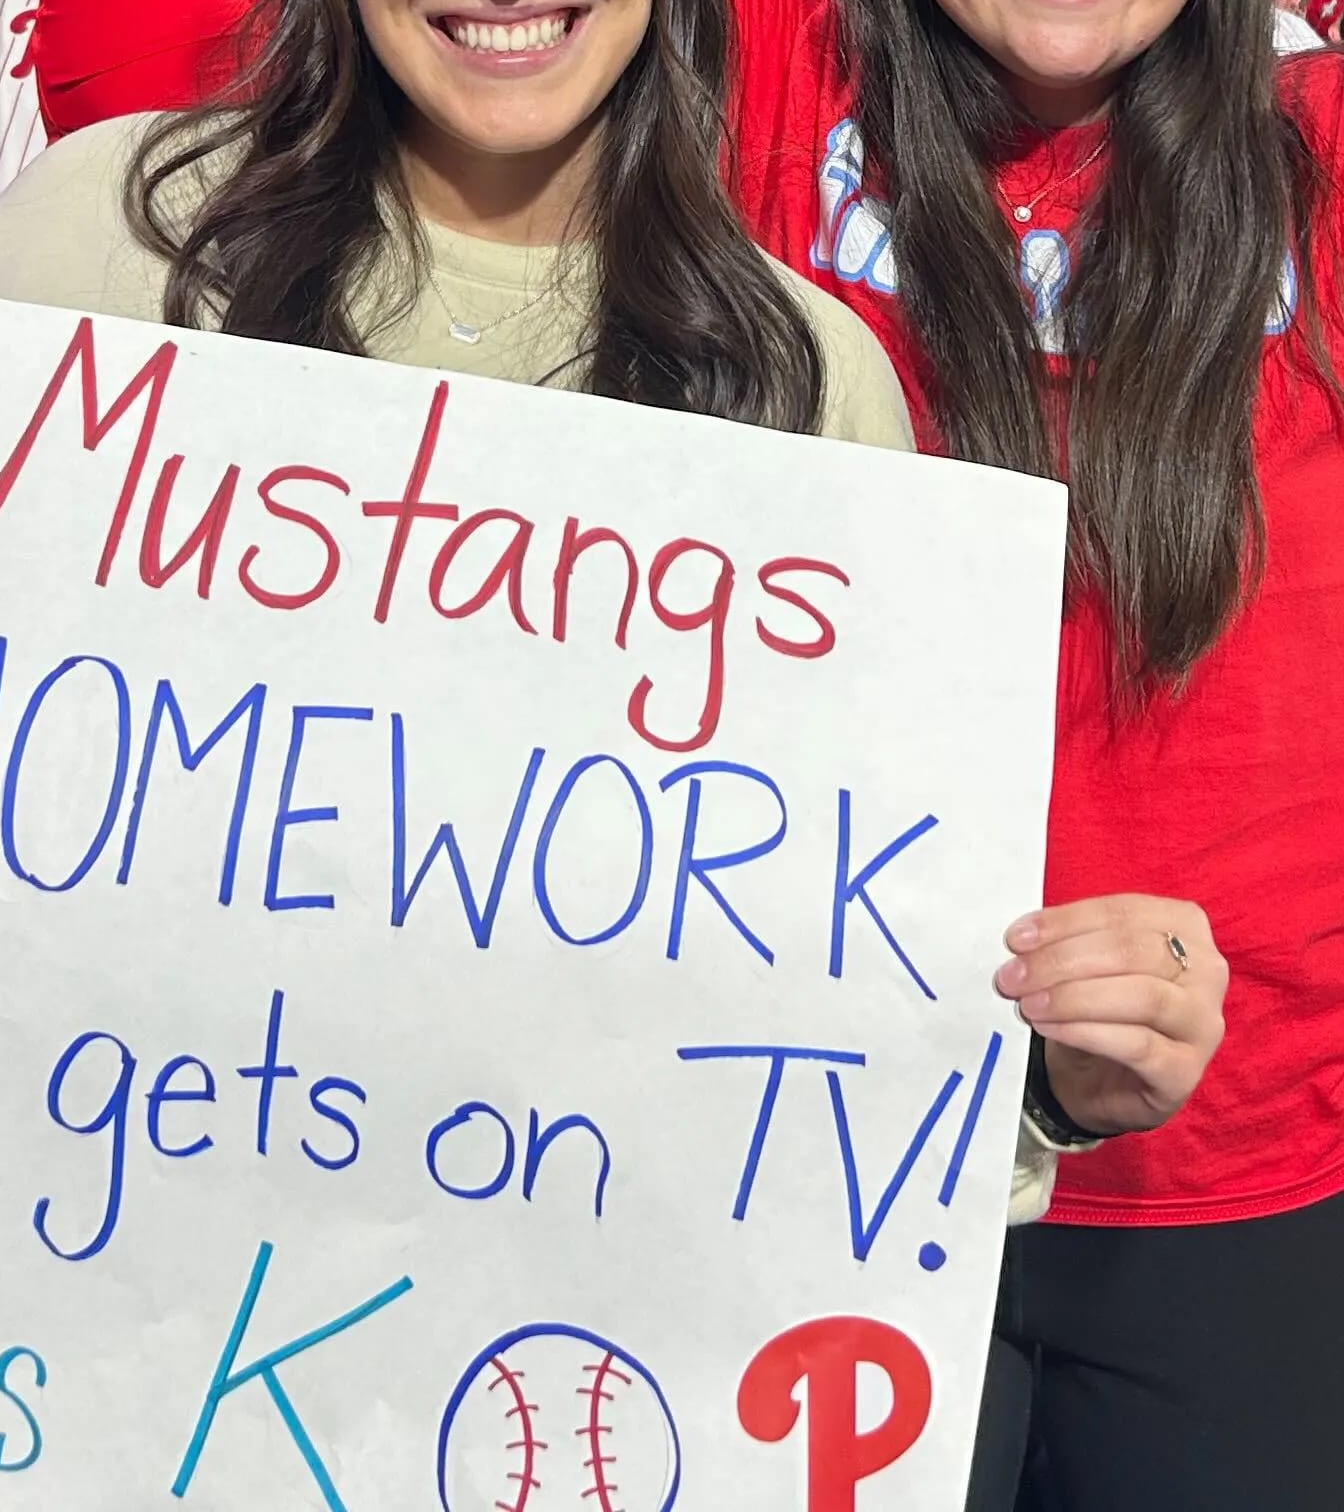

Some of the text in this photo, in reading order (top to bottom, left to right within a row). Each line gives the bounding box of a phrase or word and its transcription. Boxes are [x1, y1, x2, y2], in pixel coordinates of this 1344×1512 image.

[34, 990, 368, 1263] gets
[425, 1100, 611, 1217] on
[677, 1032, 1004, 1272] TV!
[170, 1240, 413, 1512] K
